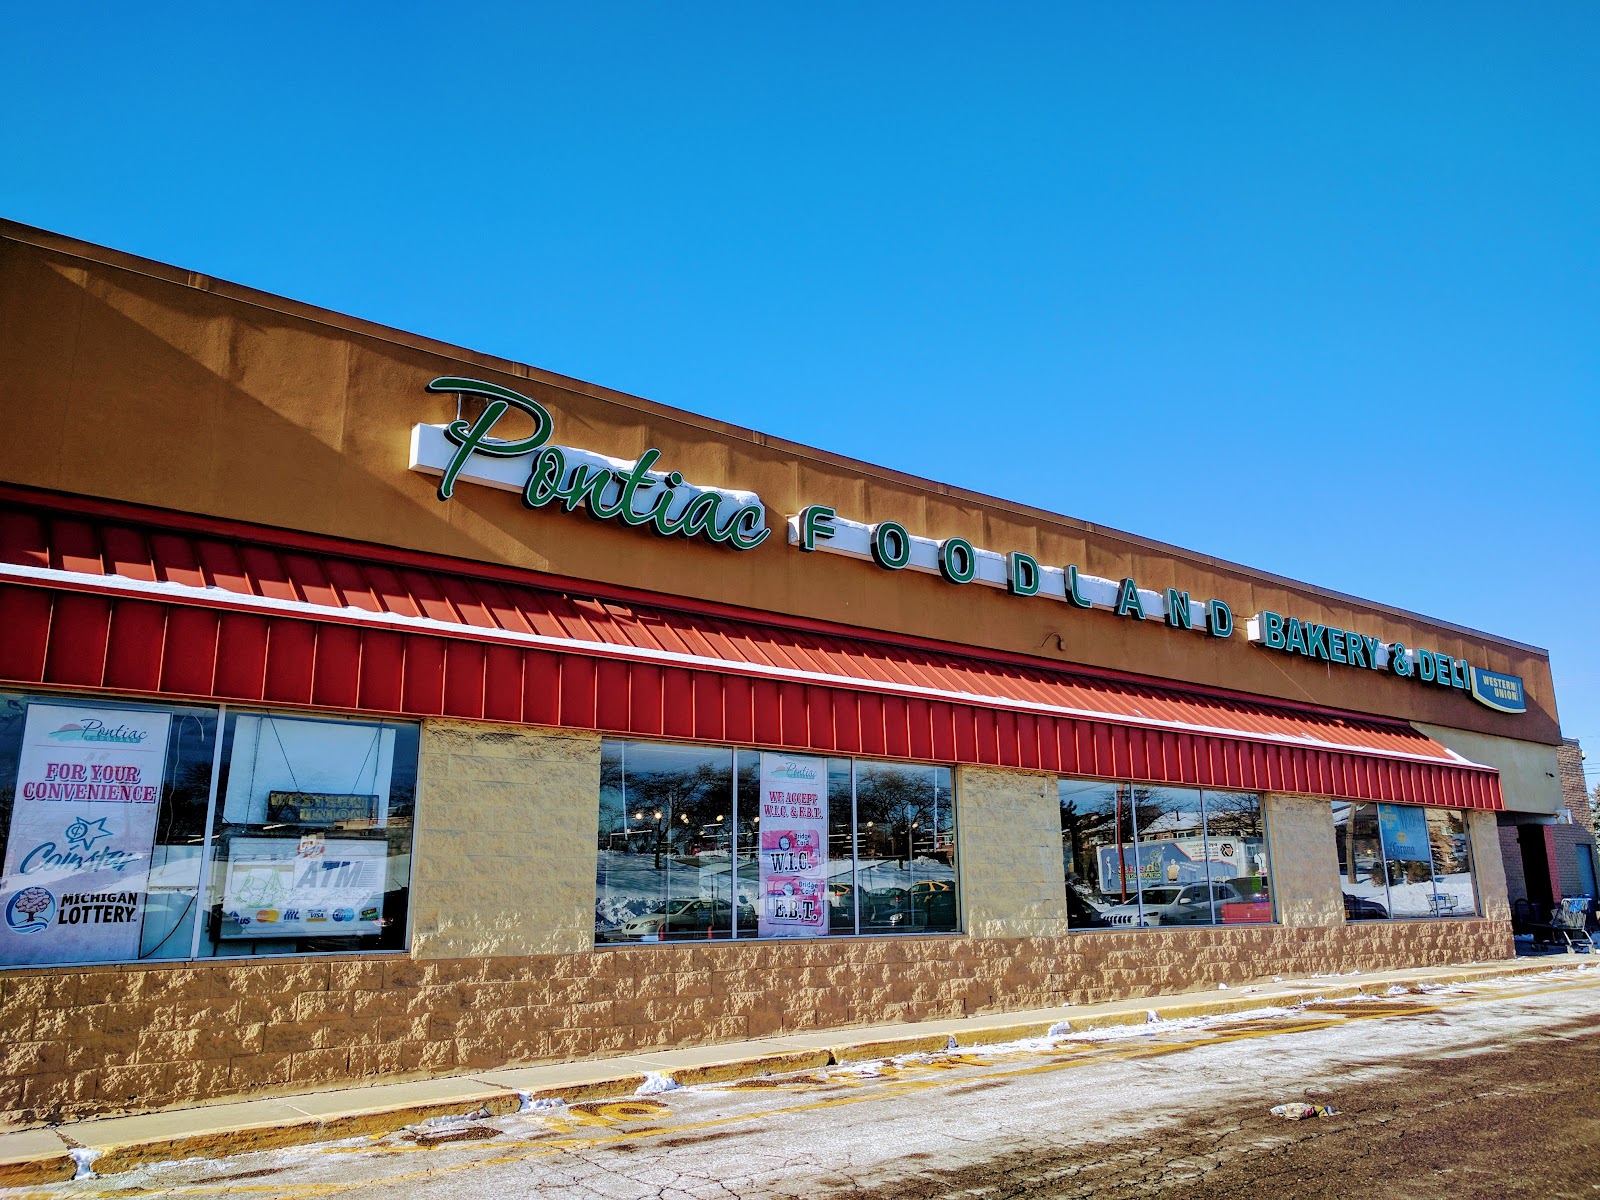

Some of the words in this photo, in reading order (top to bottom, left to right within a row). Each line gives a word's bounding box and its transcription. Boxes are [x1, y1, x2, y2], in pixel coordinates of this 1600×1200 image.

[424, 376, 771, 550] Pontiac
[1263, 610, 1381, 670] BAKERY
[1392, 642, 1412, 677] &
[1418, 648, 1471, 690] DELI
[1483, 675, 1517, 691] WESTERN
[1494, 687, 1519, 701] UNION
[80, 718, 148, 739] Pontiac
[45, 763, 86, 781] FOR
[91, 765, 141, 784] YOUR
[23, 782, 156, 803] CONVENIENCE
[271, 793, 367, 809] WESTERN
[769, 791, 784, 803] WE
[785, 792, 817, 805] ACCEPT
[300, 808, 368, 820] UNION
[790, 806, 798, 818] &
[20, 841, 142, 875] Coinstar
[770, 852, 812, 873] W.I.C.
[296, 861, 364, 888] ATM
[60, 892, 138, 907] MICHIGAN
[775, 899, 818, 920] E.B.T.
[58, 905, 135, 924] LOTTERY
